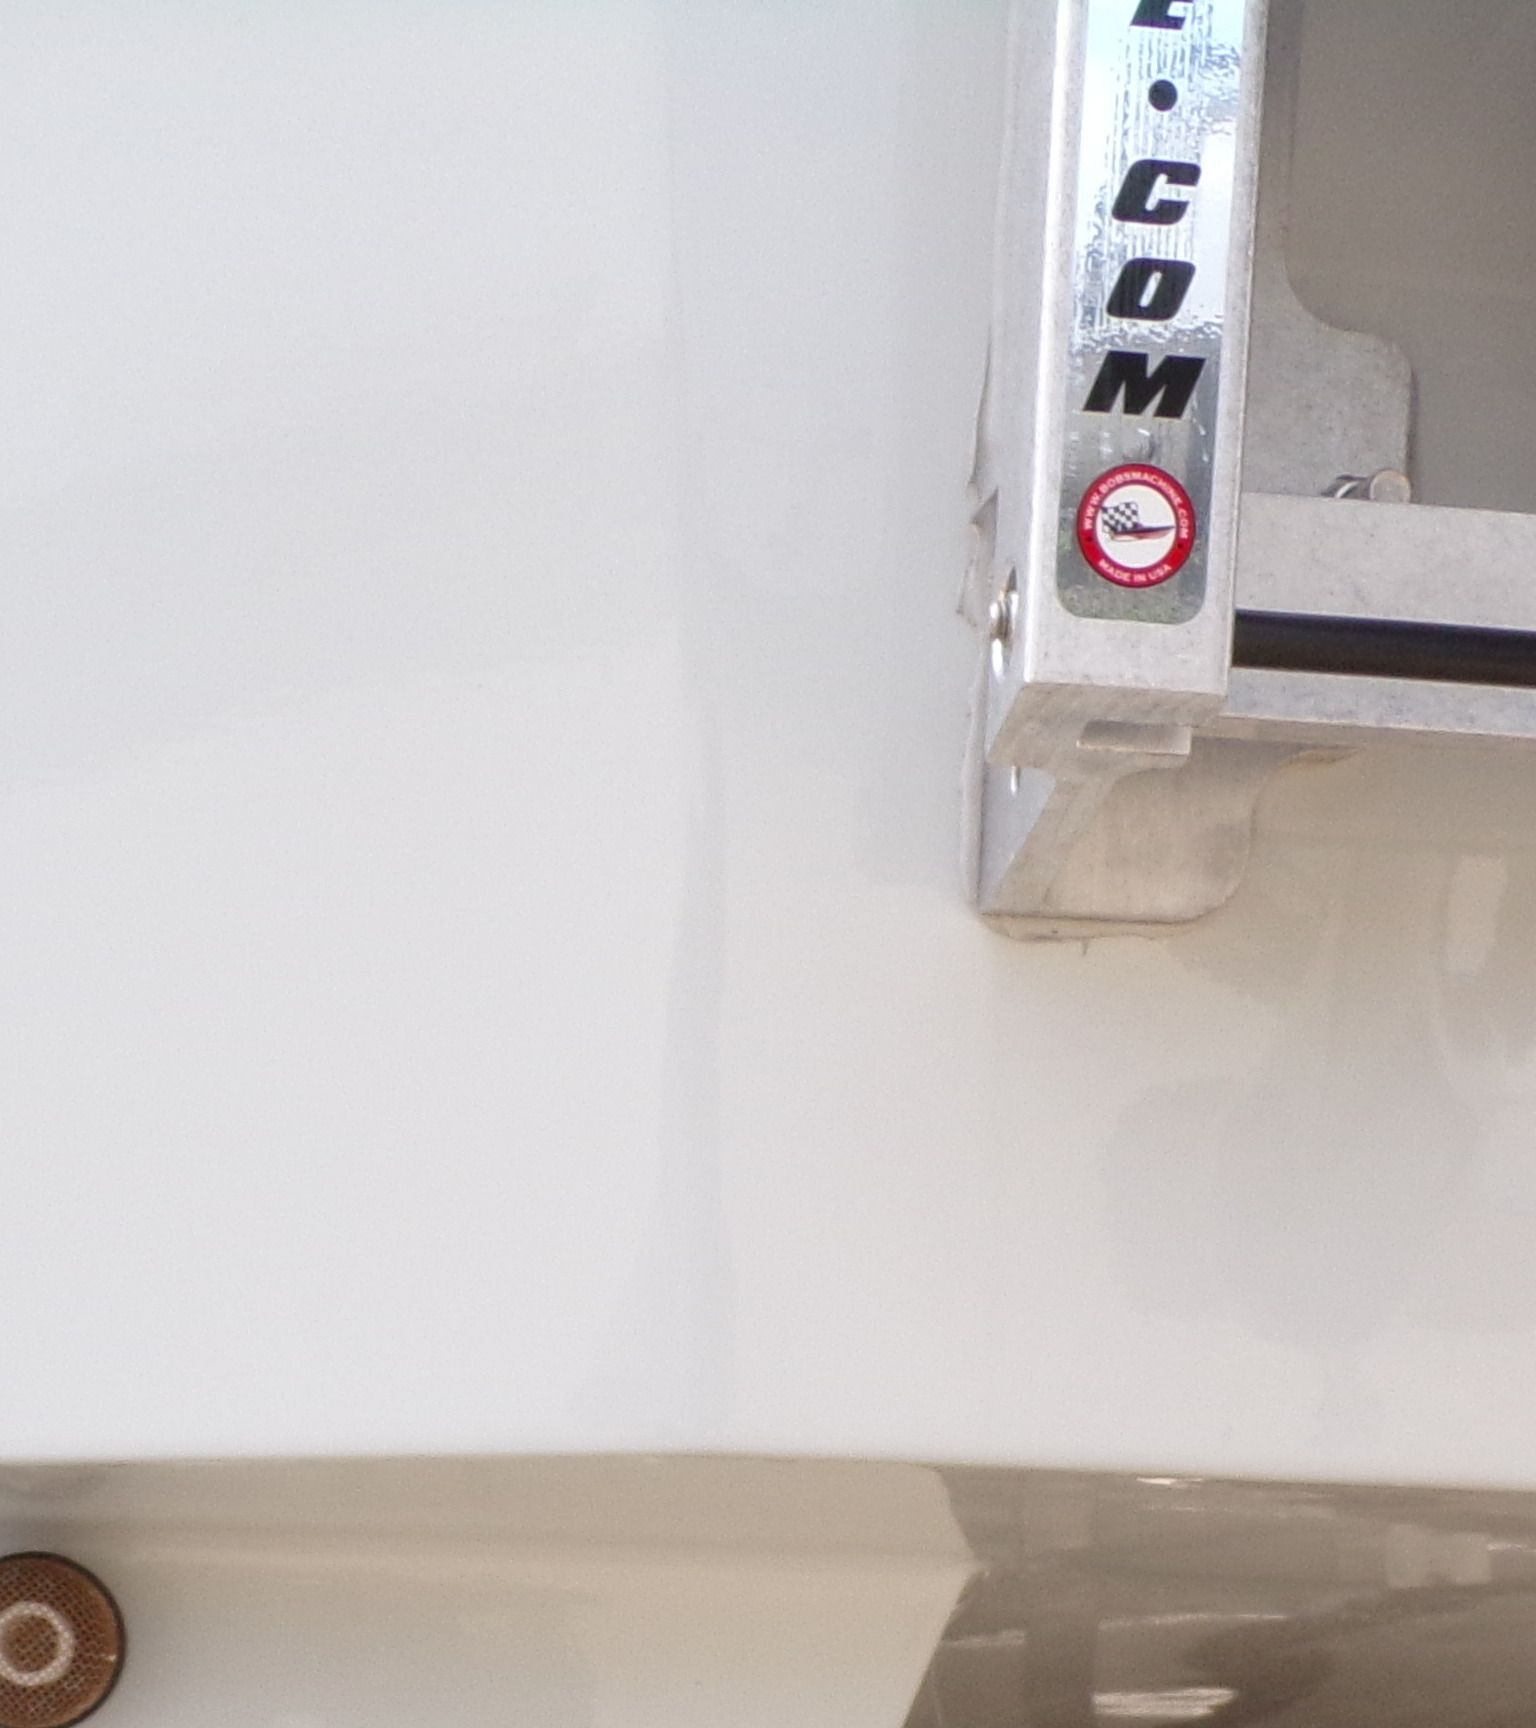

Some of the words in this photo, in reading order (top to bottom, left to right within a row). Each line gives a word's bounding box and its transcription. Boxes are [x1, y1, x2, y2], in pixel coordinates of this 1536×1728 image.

[1099, 559, 1132, 582] MADE
[1133, 572, 1147, 582] IN
[1147, 563, 1172, 581] USA
